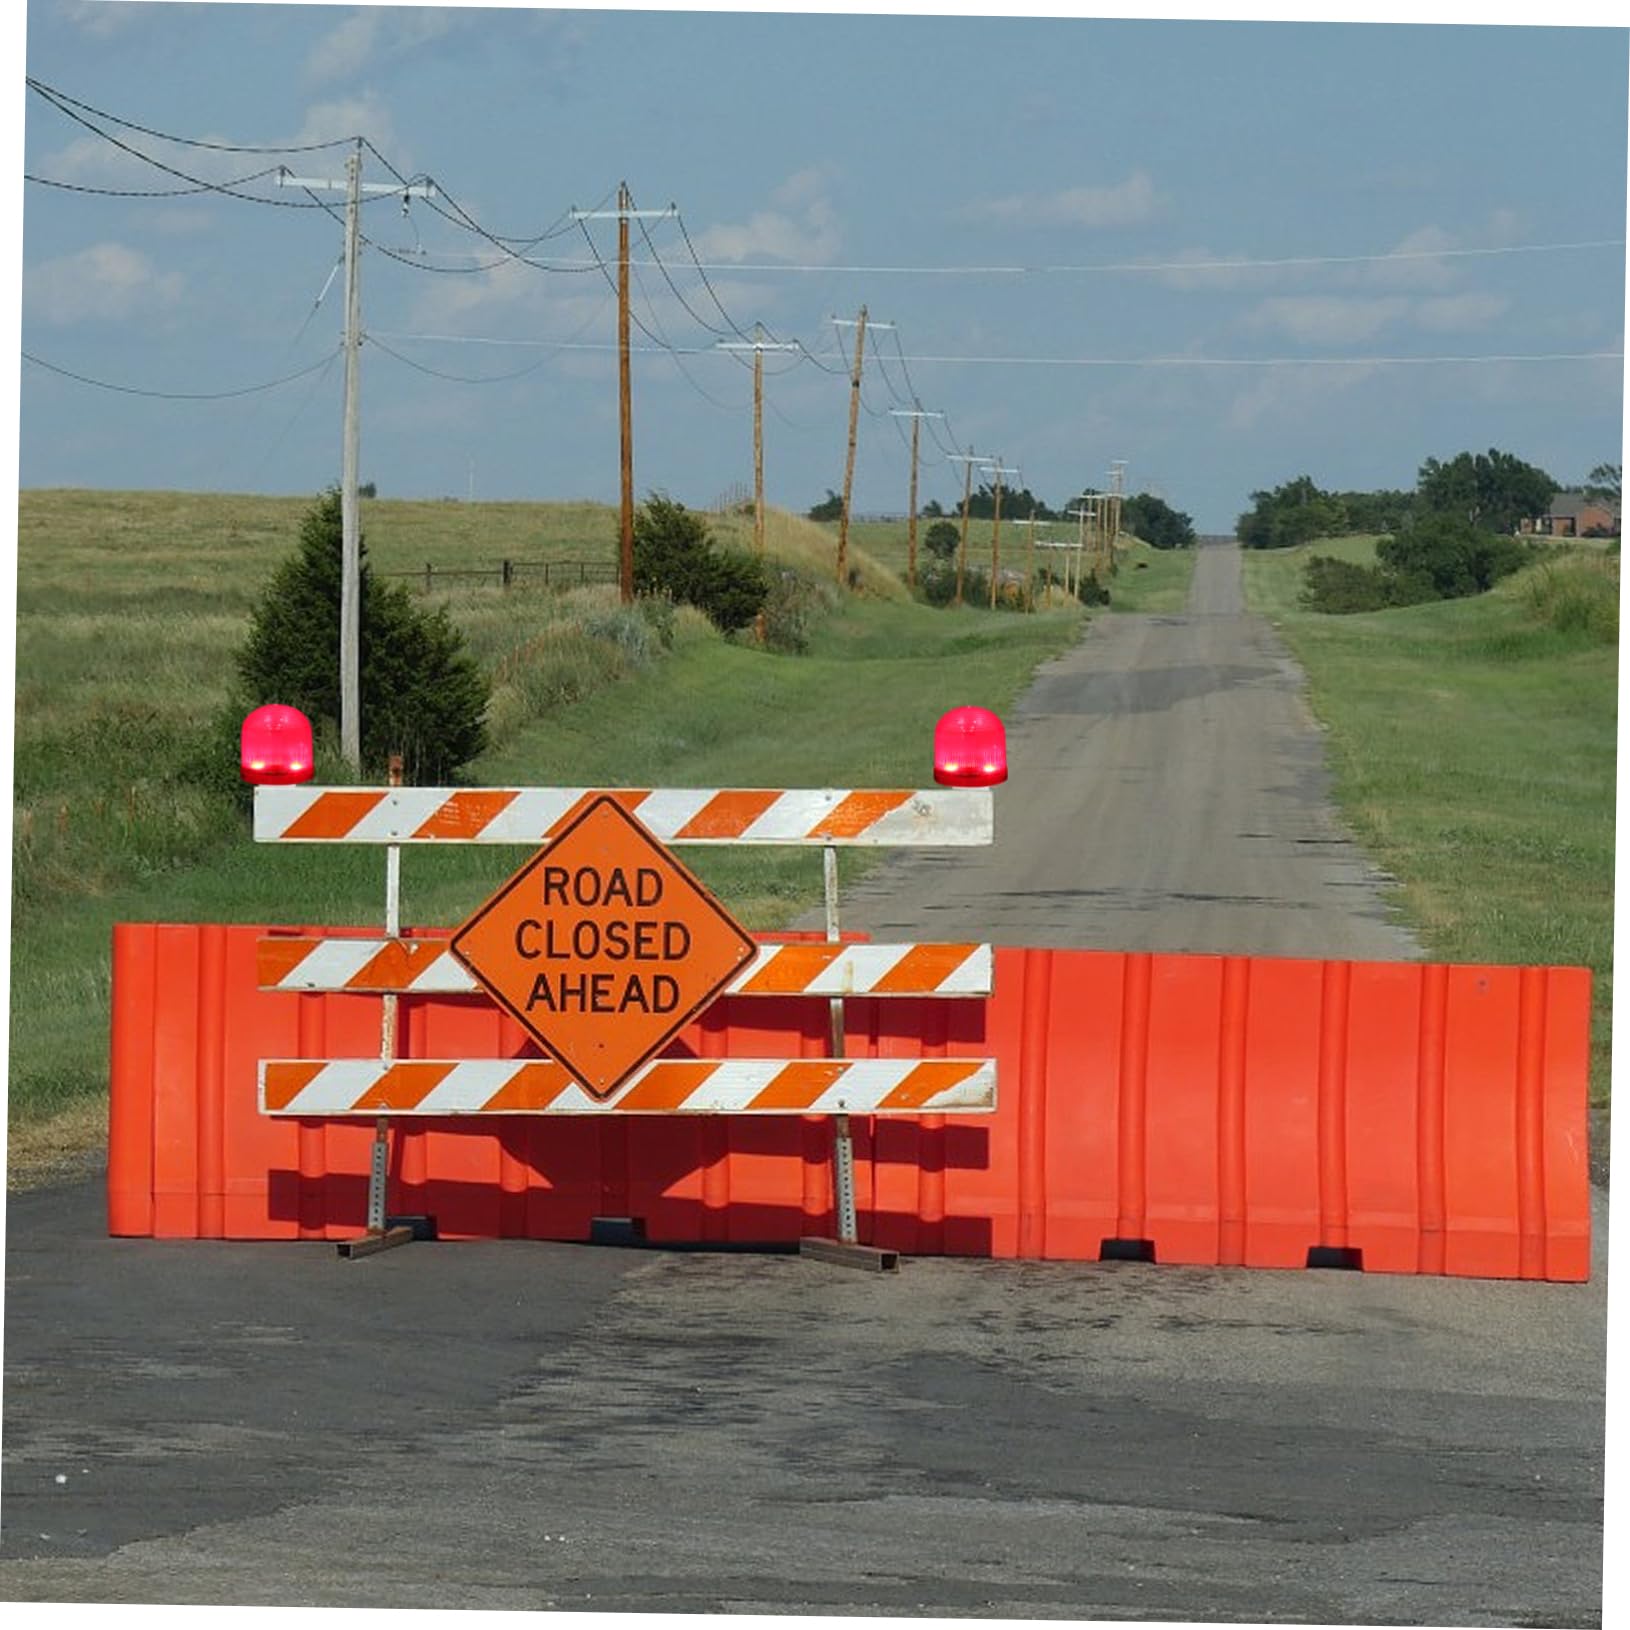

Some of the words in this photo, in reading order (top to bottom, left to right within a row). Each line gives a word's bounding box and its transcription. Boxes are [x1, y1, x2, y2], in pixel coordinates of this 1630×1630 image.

[543, 866, 663, 907] ROAD
[515, 919, 691, 961] CLOSED
[525, 973, 680, 1014] AHEAD
